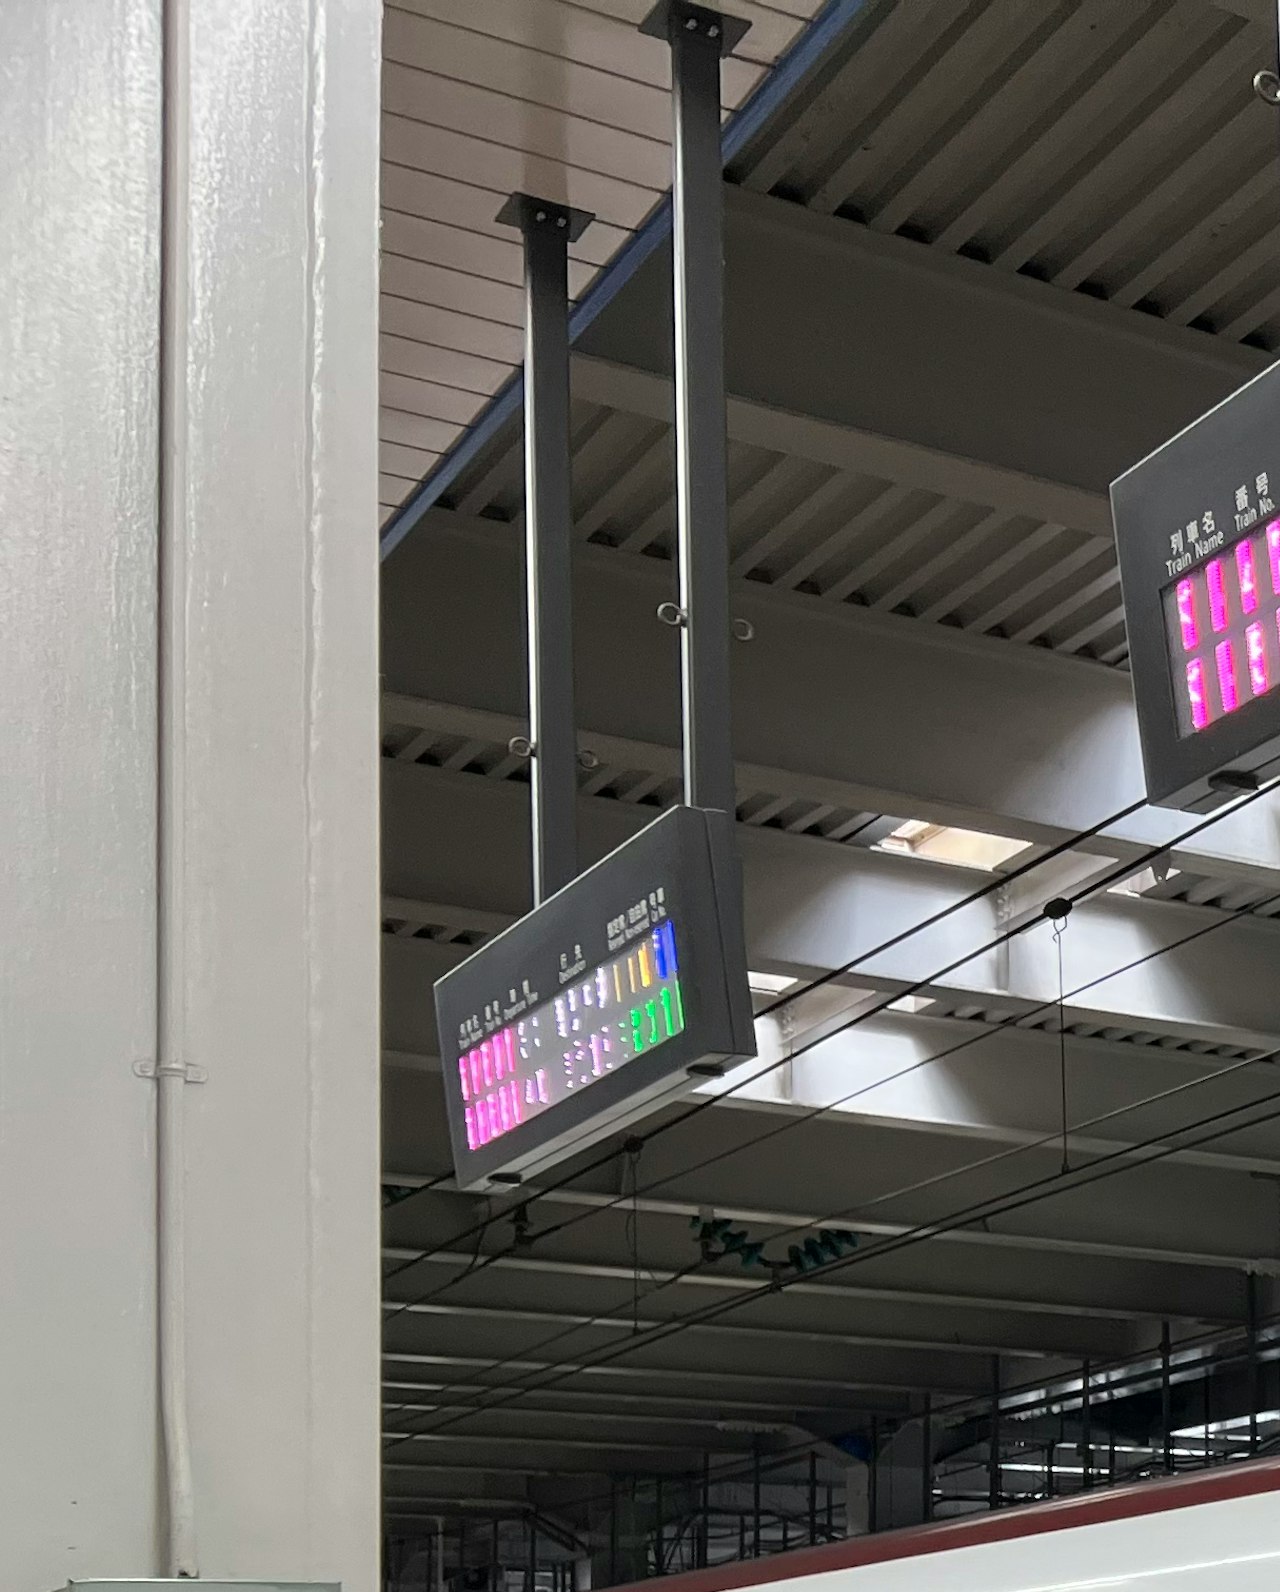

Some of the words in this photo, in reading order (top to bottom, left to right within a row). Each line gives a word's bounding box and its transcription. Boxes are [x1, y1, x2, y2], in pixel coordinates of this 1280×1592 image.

[1234, 507, 1258, 532] Train
[1259, 496, 1276, 516] No.
[1165, 551, 1193, 577] Train
[1195, 531, 1225, 559] Name
